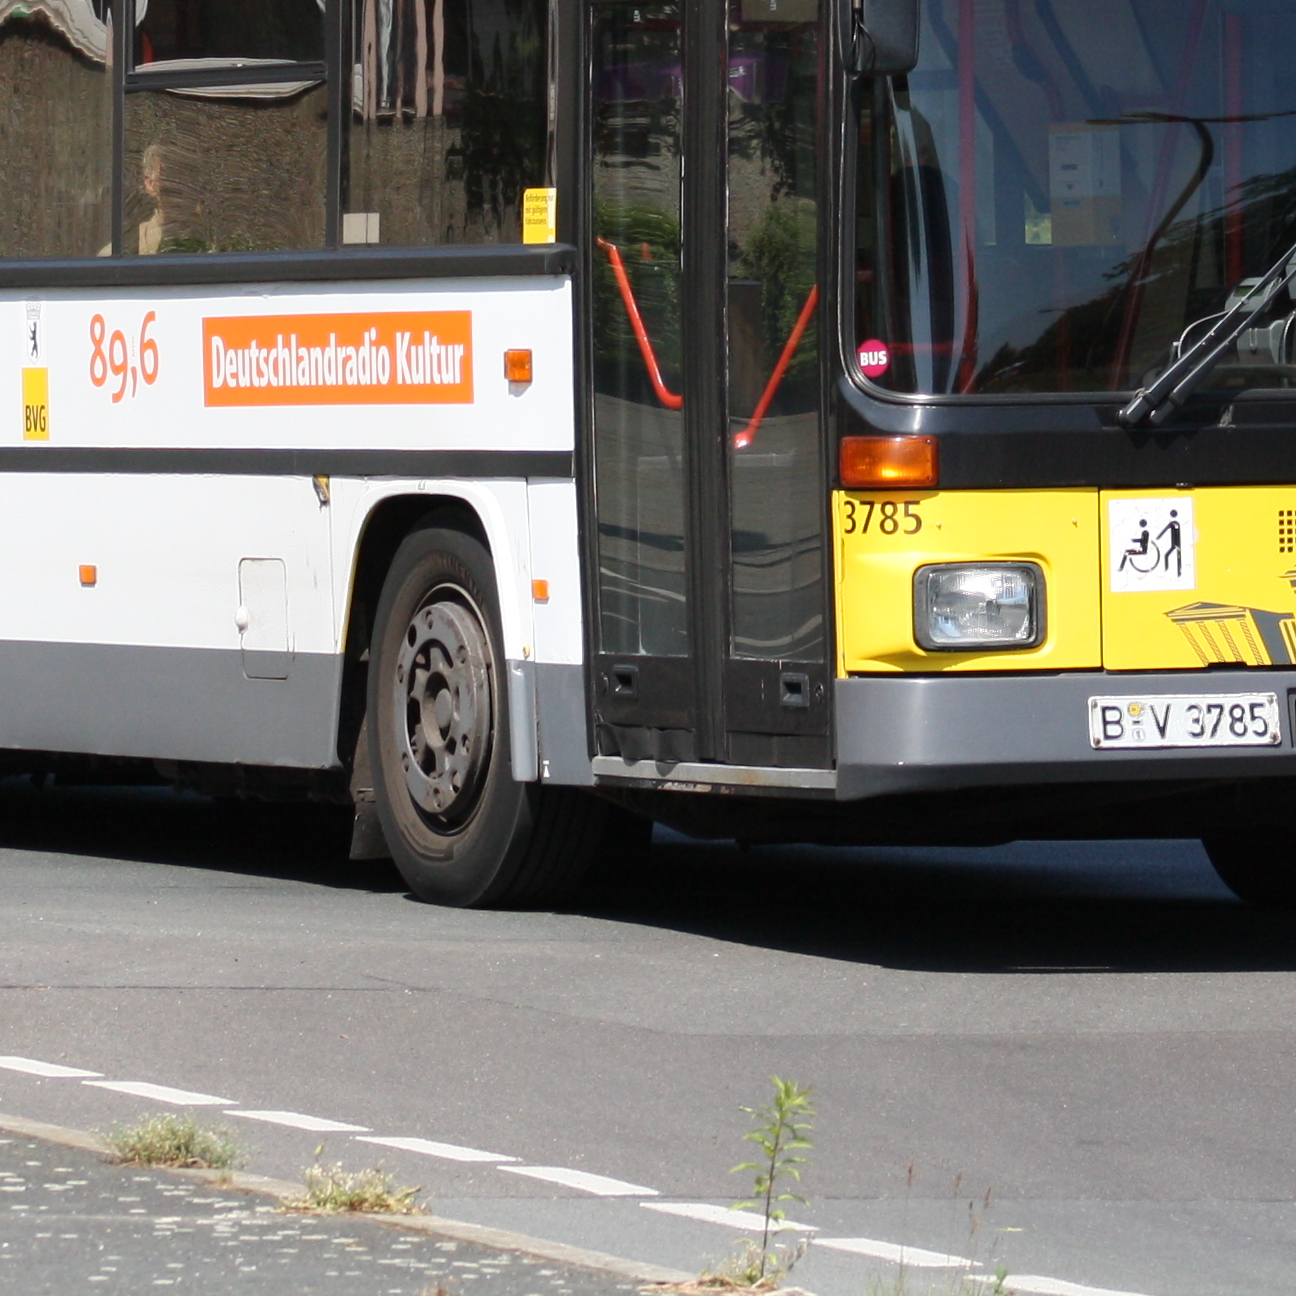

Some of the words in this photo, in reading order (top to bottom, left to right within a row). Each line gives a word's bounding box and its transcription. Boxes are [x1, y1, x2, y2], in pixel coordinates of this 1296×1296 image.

[89, 310, 159, 404] 89,6
[211, 327, 391, 389] Deutschlandradio
[395, 331, 464, 386] Kultur
[860, 350, 887, 367] BUS
[25, 403, 47, 433] BVG
[843, 499, 922, 536] 3785
[1185, 702, 1269, 739] 3785
